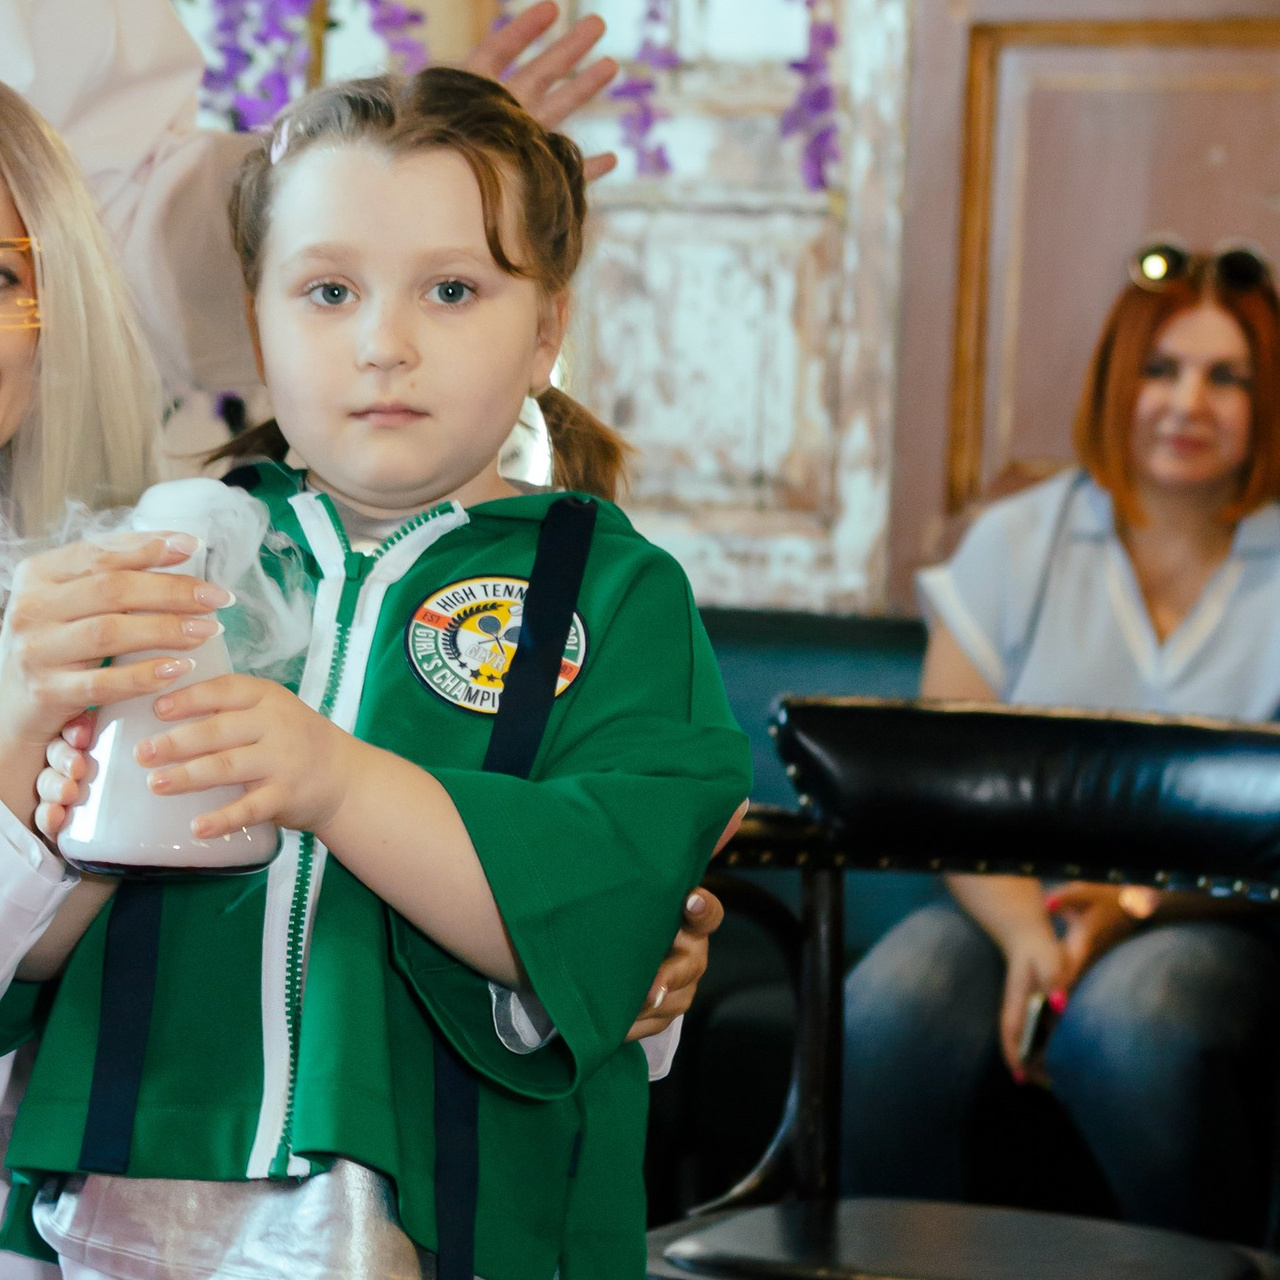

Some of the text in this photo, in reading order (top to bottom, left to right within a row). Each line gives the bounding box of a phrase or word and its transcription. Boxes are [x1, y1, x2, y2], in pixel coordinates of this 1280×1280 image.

[436, 584, 526, 613] HIGH TENN
[422, 611, 441, 624] EST
[414, 628, 496, 708] GIRL'S CHAMPI
